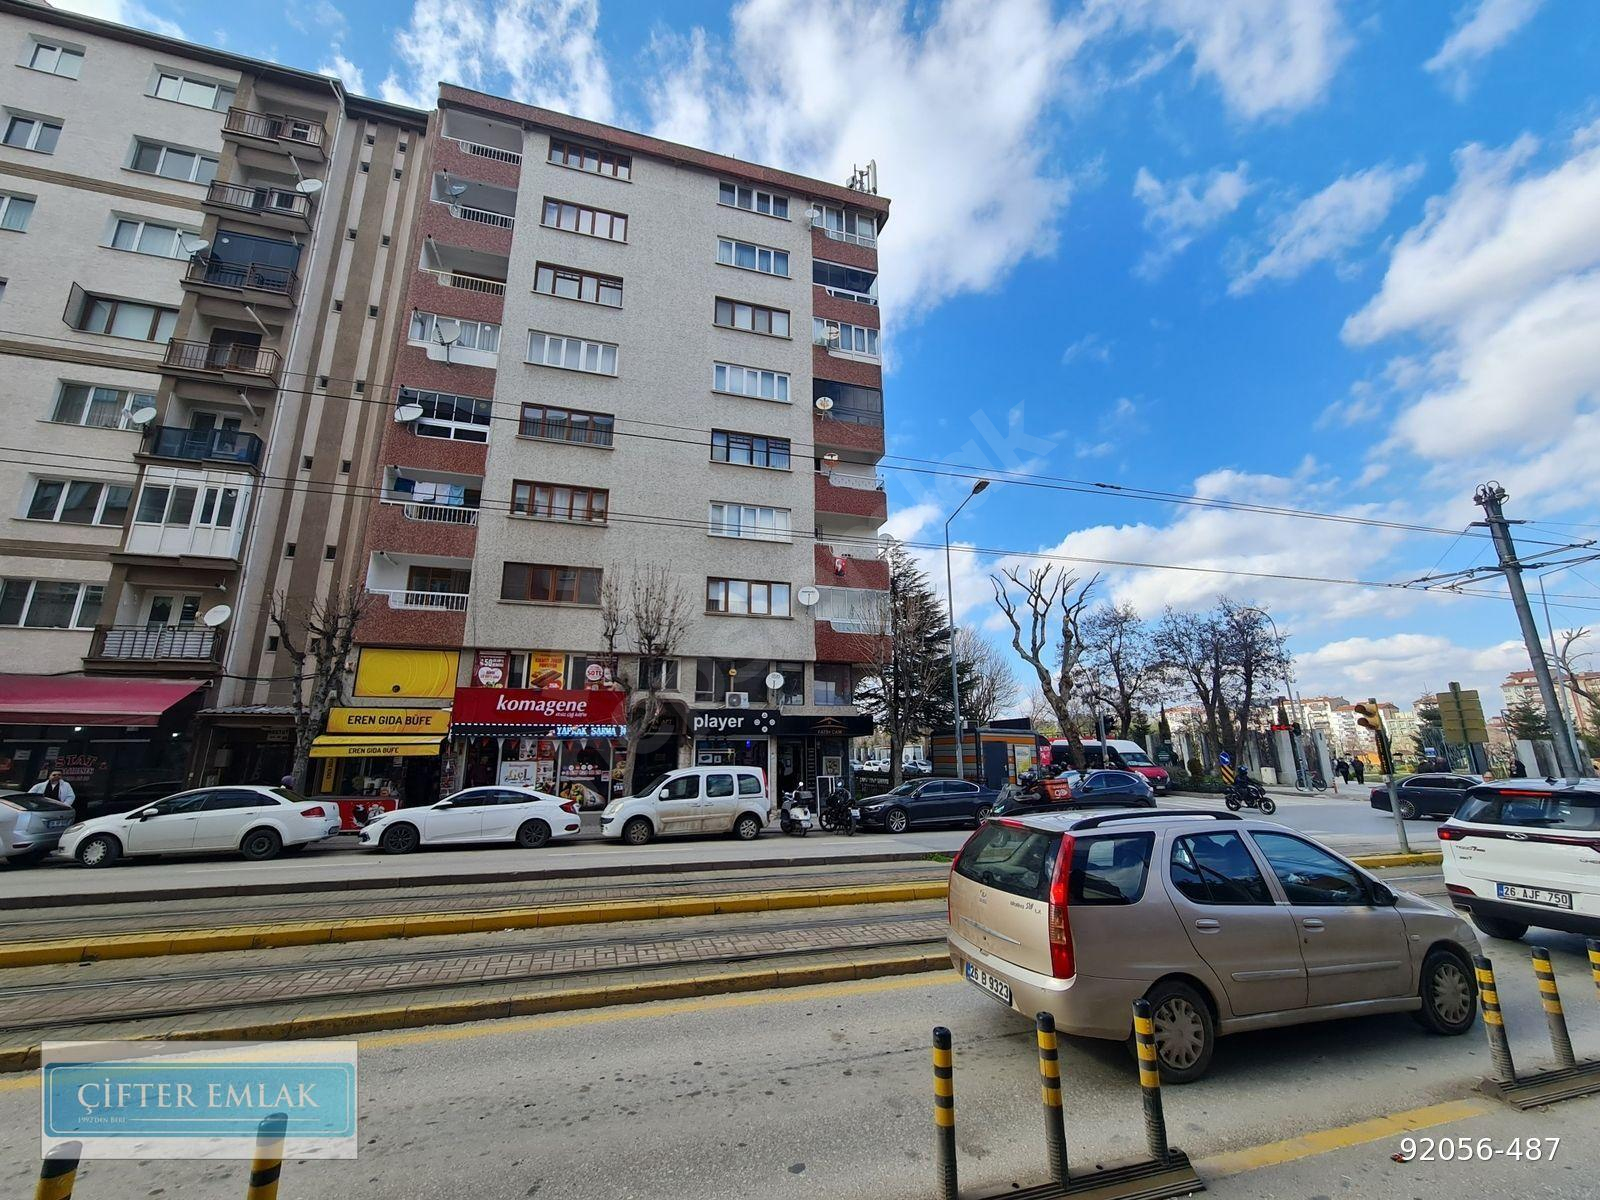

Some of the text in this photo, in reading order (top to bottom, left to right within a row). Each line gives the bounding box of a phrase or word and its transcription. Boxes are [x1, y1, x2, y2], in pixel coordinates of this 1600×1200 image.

[496, 694, 588, 717] komagene
[347, 715, 433, 726] EREN GIDA BÜFE
[693, 714, 744, 732] player
[1503, 886, 1568, 905] 26 AJF 750
[970, 965, 1009, 999] 26 B 9323
